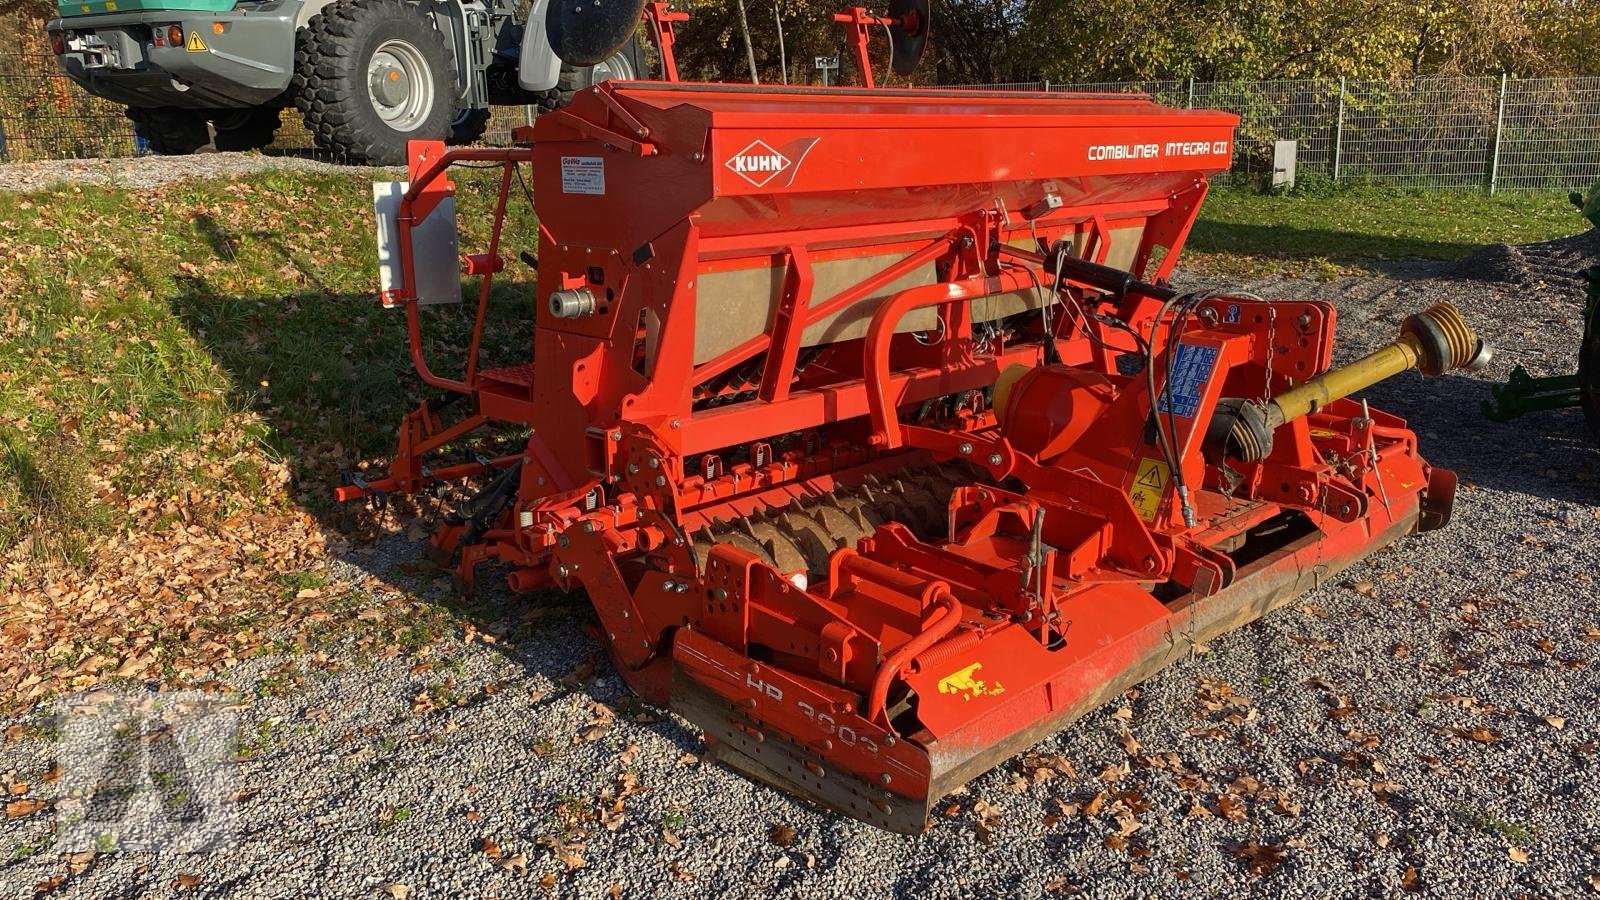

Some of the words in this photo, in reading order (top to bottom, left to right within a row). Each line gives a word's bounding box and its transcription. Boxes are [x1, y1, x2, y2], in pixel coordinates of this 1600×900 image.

[1088, 144, 1159, 161] COMBILINER
[1165, 142, 1210, 157] INTEGRA
[1213, 141, 1227, 154] GII
[735, 155, 782, 172] KUHN
